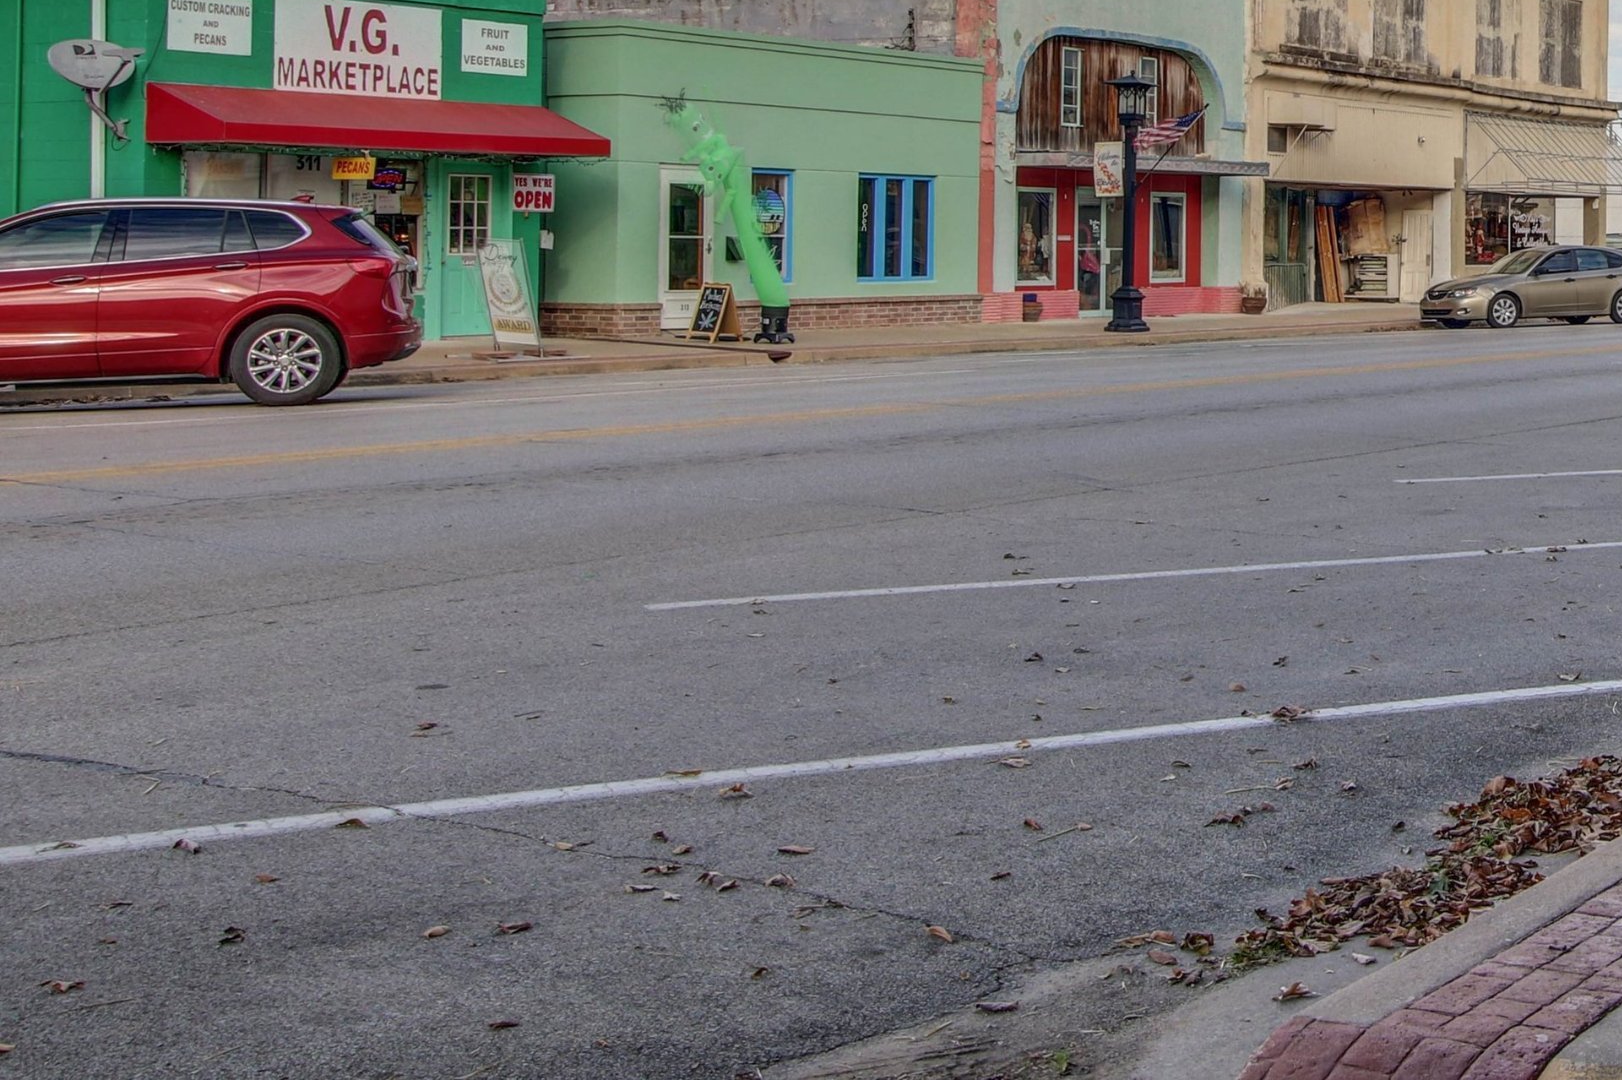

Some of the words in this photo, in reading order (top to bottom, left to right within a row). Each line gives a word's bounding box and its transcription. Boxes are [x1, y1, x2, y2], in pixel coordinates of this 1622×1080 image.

[170, 0, 206, 13] CUSTOM
[207, 3, 250, 17] CRACKING
[202, 20, 219, 28] AND
[324, 4, 400, 56] V.G.
[193, 32, 227, 46] PECANS
[481, 27, 510, 40] FRUIT
[485, 44, 505, 52] AND
[463, 54, 526, 69] VEGETABLES
[277, 56, 439, 96] MARKETPLACE
[295, 156, 321, 171] 311
[336, 160, 370, 174] PECANS
[515, 176, 528, 187] YES
[532, 177, 552, 188] WE'RE
[514, 190, 552, 209] OPEN
[497, 318, 532, 331] AWARD
